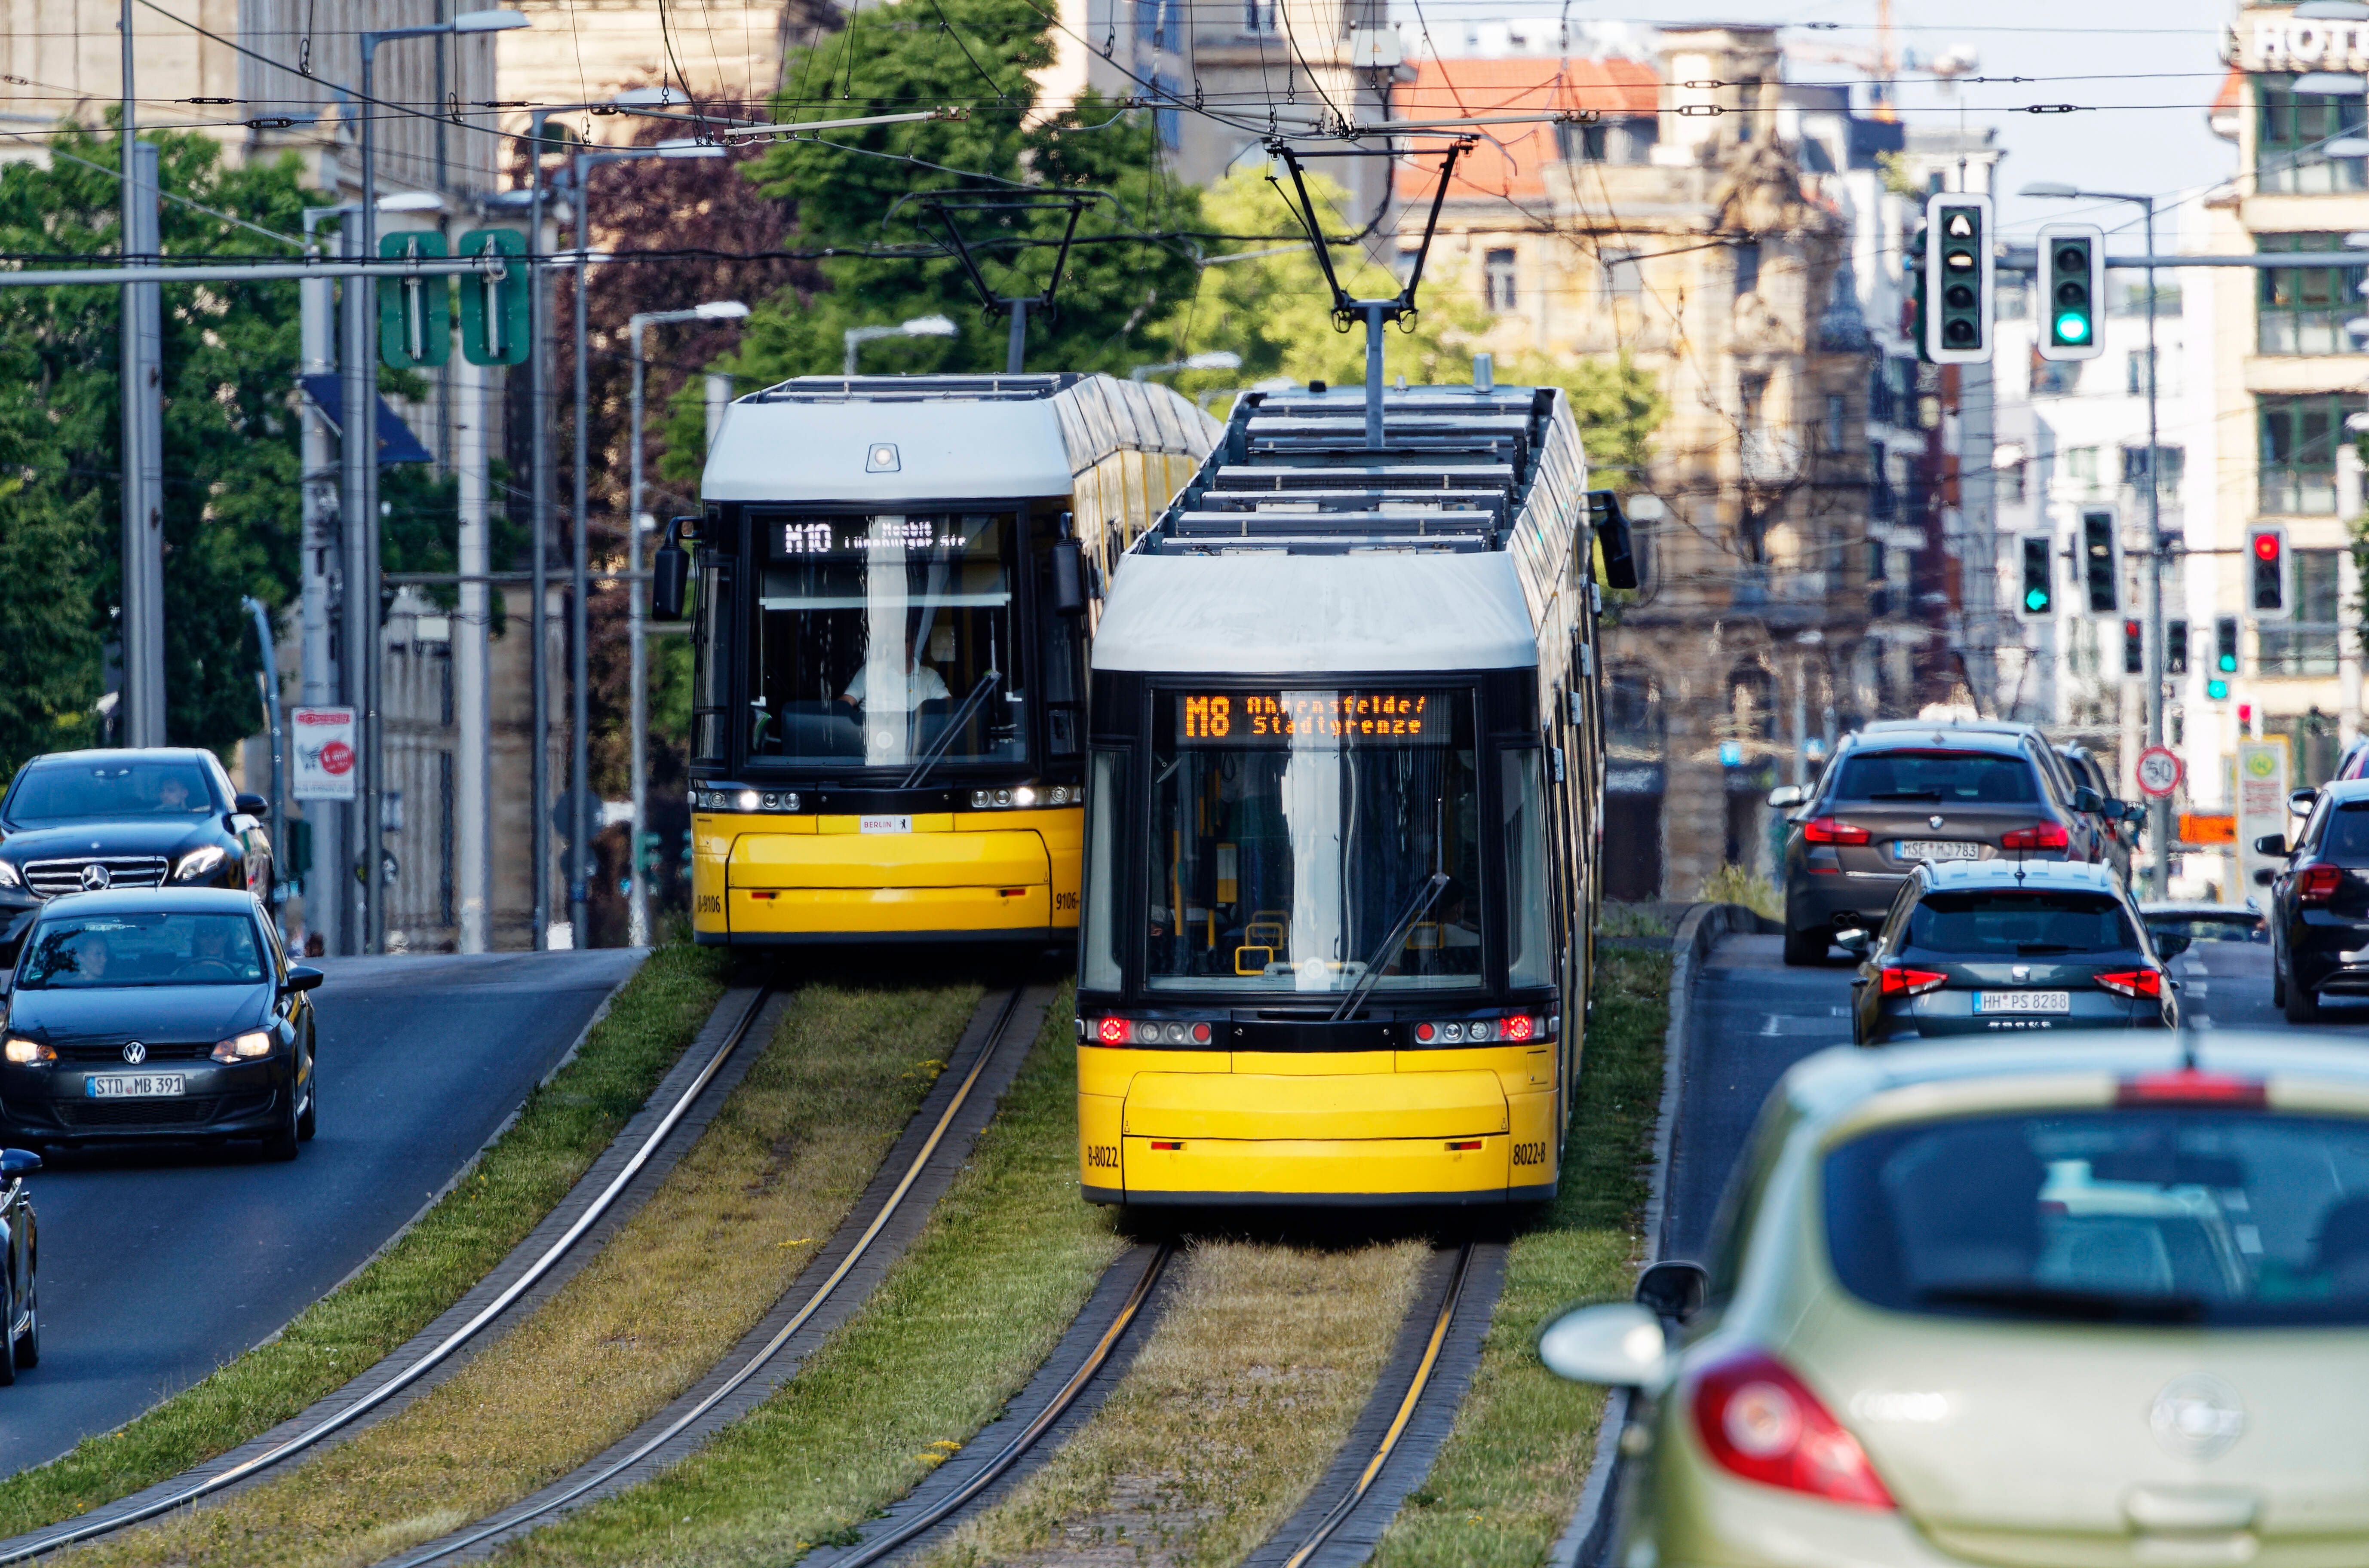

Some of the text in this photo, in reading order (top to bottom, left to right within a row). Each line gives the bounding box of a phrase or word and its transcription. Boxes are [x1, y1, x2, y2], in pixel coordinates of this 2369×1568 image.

[786, 523, 832, 554] M10
[1246, 695, 1426, 714] Ahrensfelde/
[1185, 696, 1230, 737] M8
[1252, 715, 1421, 736] Stadtgrenze
[2145, 760, 2171, 782] 50
[1955, 843, 1976, 857] 783
[1983, 995, 2001, 1009] HH
[2012, 995, 2029, 1008] PS
[96, 1077, 182, 1095] STD MB 391
[1088, 1145, 1119, 1168] B-8022
[1513, 1141, 1546, 1166] 8022-B
